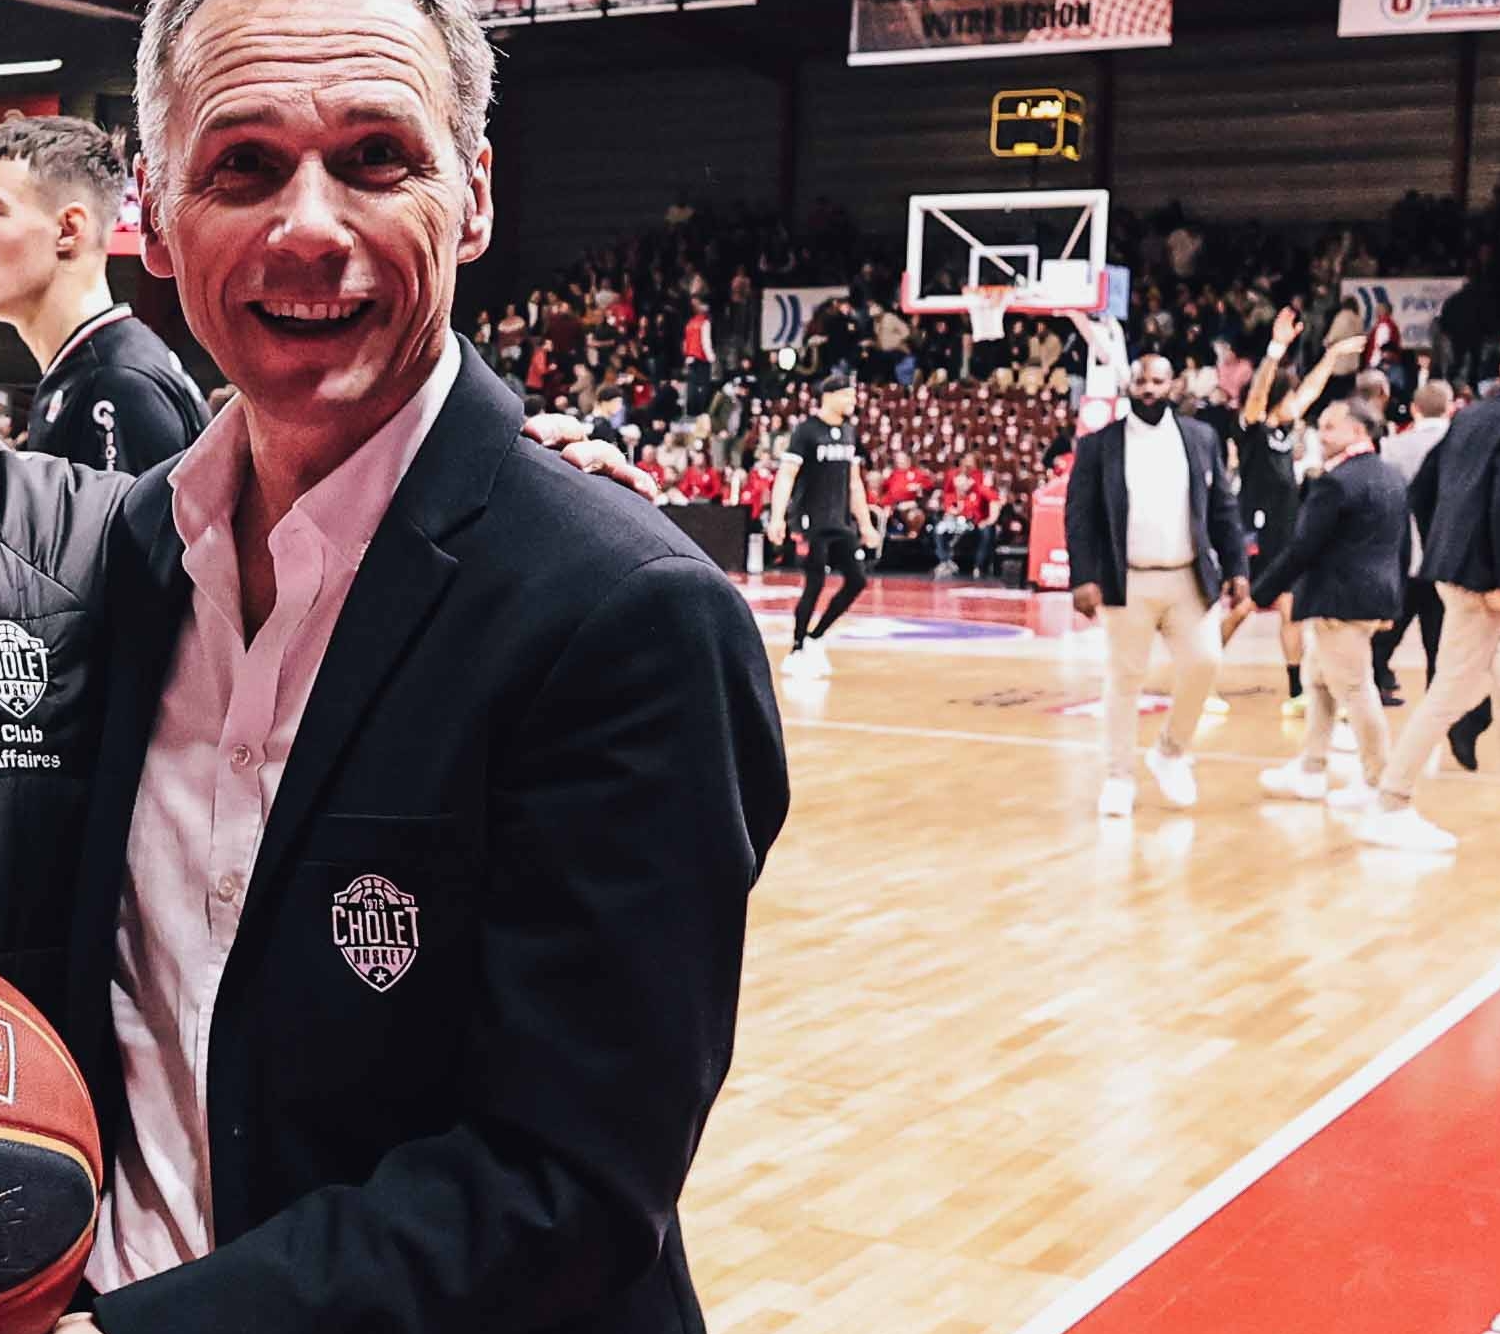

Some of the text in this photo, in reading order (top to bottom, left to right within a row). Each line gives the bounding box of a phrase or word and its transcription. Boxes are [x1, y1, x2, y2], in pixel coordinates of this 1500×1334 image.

[1, 724, 44, 744] Club
[331, 905, 420, 948] CHOLET
[353, 949, 405, 966] BASKET
